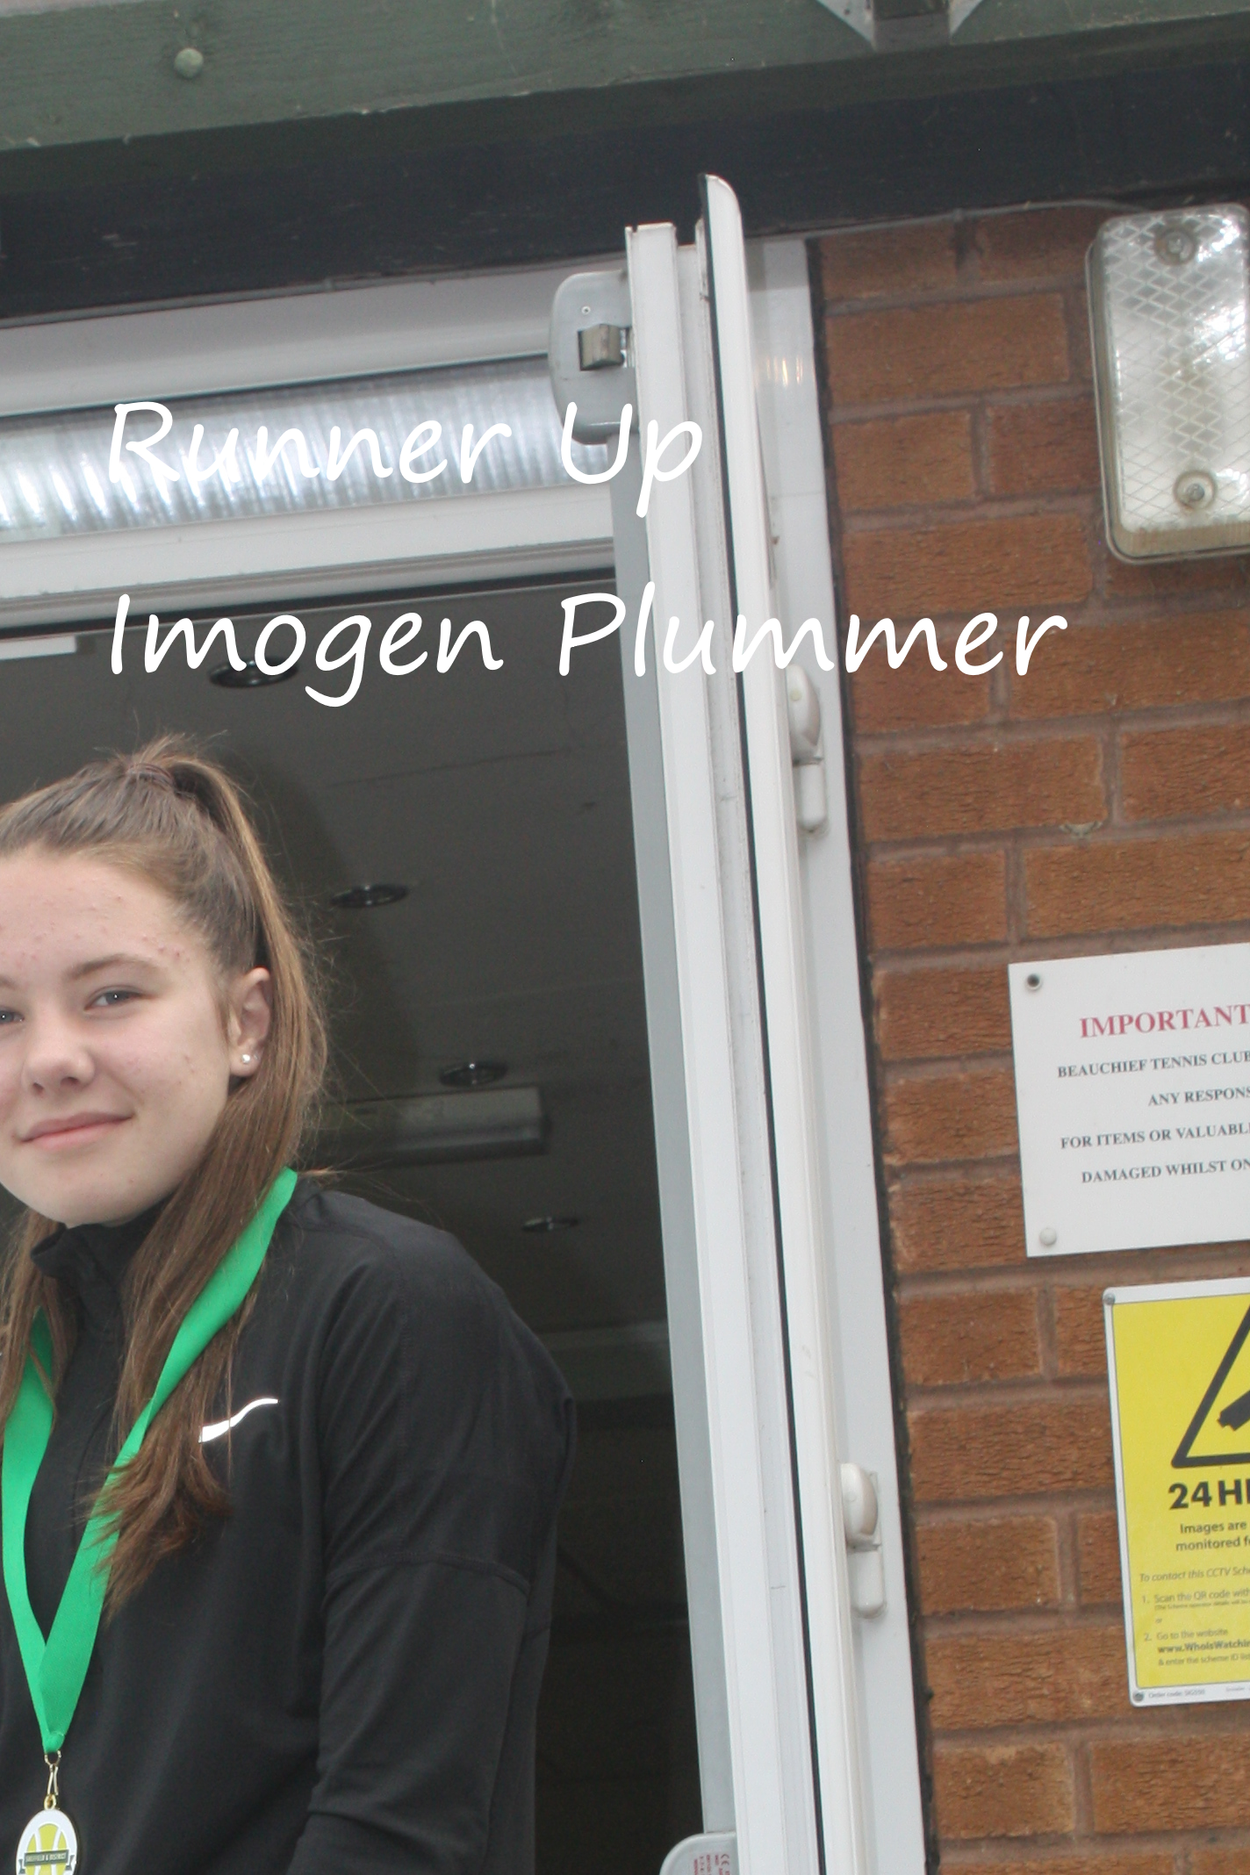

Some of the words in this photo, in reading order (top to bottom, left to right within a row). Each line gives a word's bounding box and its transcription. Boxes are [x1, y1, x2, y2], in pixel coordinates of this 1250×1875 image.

[1079, 1004, 1250, 1038] IMPORTANT
[1057, 1059, 1148, 1078] BEAUCHIEF
[1150, 1054, 1207, 1070] TENNIS
[1148, 1092, 1180, 1107] ANY
[1061, 1135, 1092, 1150] FOR
[1097, 1131, 1145, 1146] ITEMS
[1149, 1129, 1172, 1142] OR
[1175, 1122, 1250, 1140] VALUABL
[1081, 1165, 1162, 1184] DAMAGED
[1166, 1160, 1226, 1177] WHILST
[1180, 1522, 1225, 1535] Images
[1228, 1521, 1247, 1531] are
[1176, 1537, 1240, 1551] monitored
[1140, 1573, 1150, 1582] To
[1152, 1571, 1186, 1580] contact
[1188, 1569, 1204, 1579] this
[1206, 1567, 1231, 1578] CCTV
[1154, 1594, 1175, 1603] Scan
[1177, 1592, 1192, 1601] the
[1194, 1591, 1207, 1600] QR
[1209, 1589, 1230, 1598] code
[1156, 1632, 1168, 1640] Go
[1170, 1631, 1179, 1639] to
[1181, 1630, 1194, 1639] the
[1196, 1628, 1228, 1637] website
